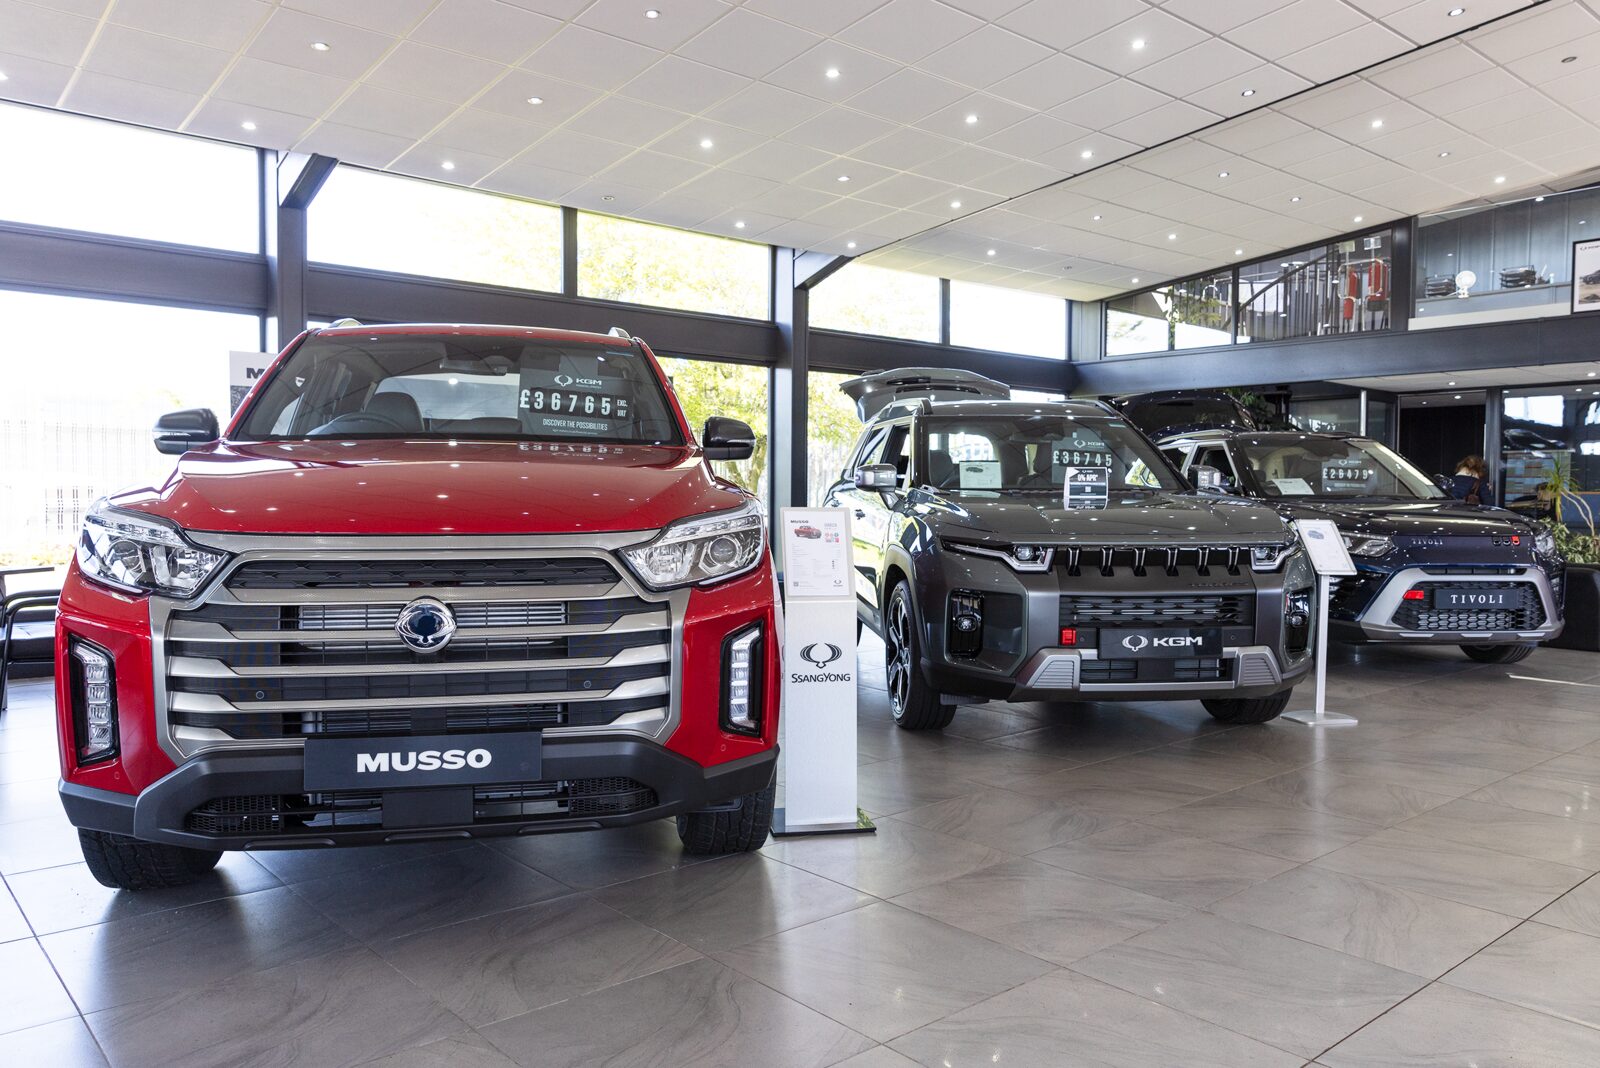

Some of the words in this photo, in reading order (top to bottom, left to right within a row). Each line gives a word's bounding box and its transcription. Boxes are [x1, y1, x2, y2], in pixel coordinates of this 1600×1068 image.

[520, 389, 611, 416] £36765
[617, 409, 627, 417] VAT
[542, 418, 567, 427] DISCOVER
[567, 420, 576, 429] THE
[576, 421, 608, 431] POSSIBILITIES
[1053, 450, 1112, 467] £36745
[1411, 537, 1443, 545] TIVOLI
[1450, 594, 1504, 604] TIVOLI
[1153, 636, 1203, 647] KGM
[356, 748, 493, 773] MUSSO
